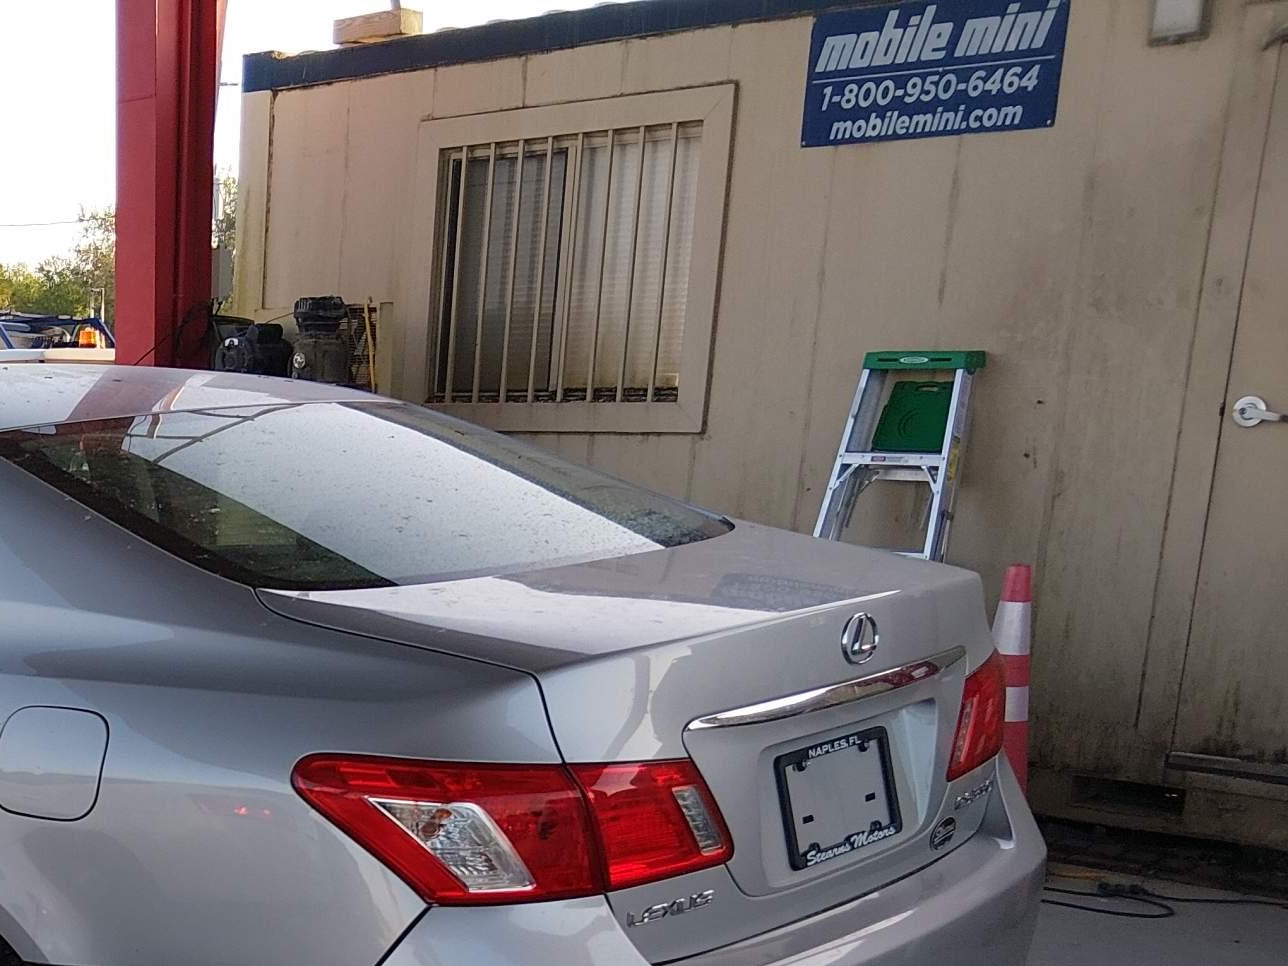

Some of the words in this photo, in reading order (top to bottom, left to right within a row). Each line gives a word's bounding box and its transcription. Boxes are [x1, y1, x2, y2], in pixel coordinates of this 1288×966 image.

[815, 4, 954, 73] mobile
[954, 0, 1060, 57] mini
[821, 64, 1040, 111] 1-800-950-6464
[829, 105, 1023, 140] mobilemini.com
[850, 826, 895, 849] Motors
[626, 889, 715, 928] LEXUS
